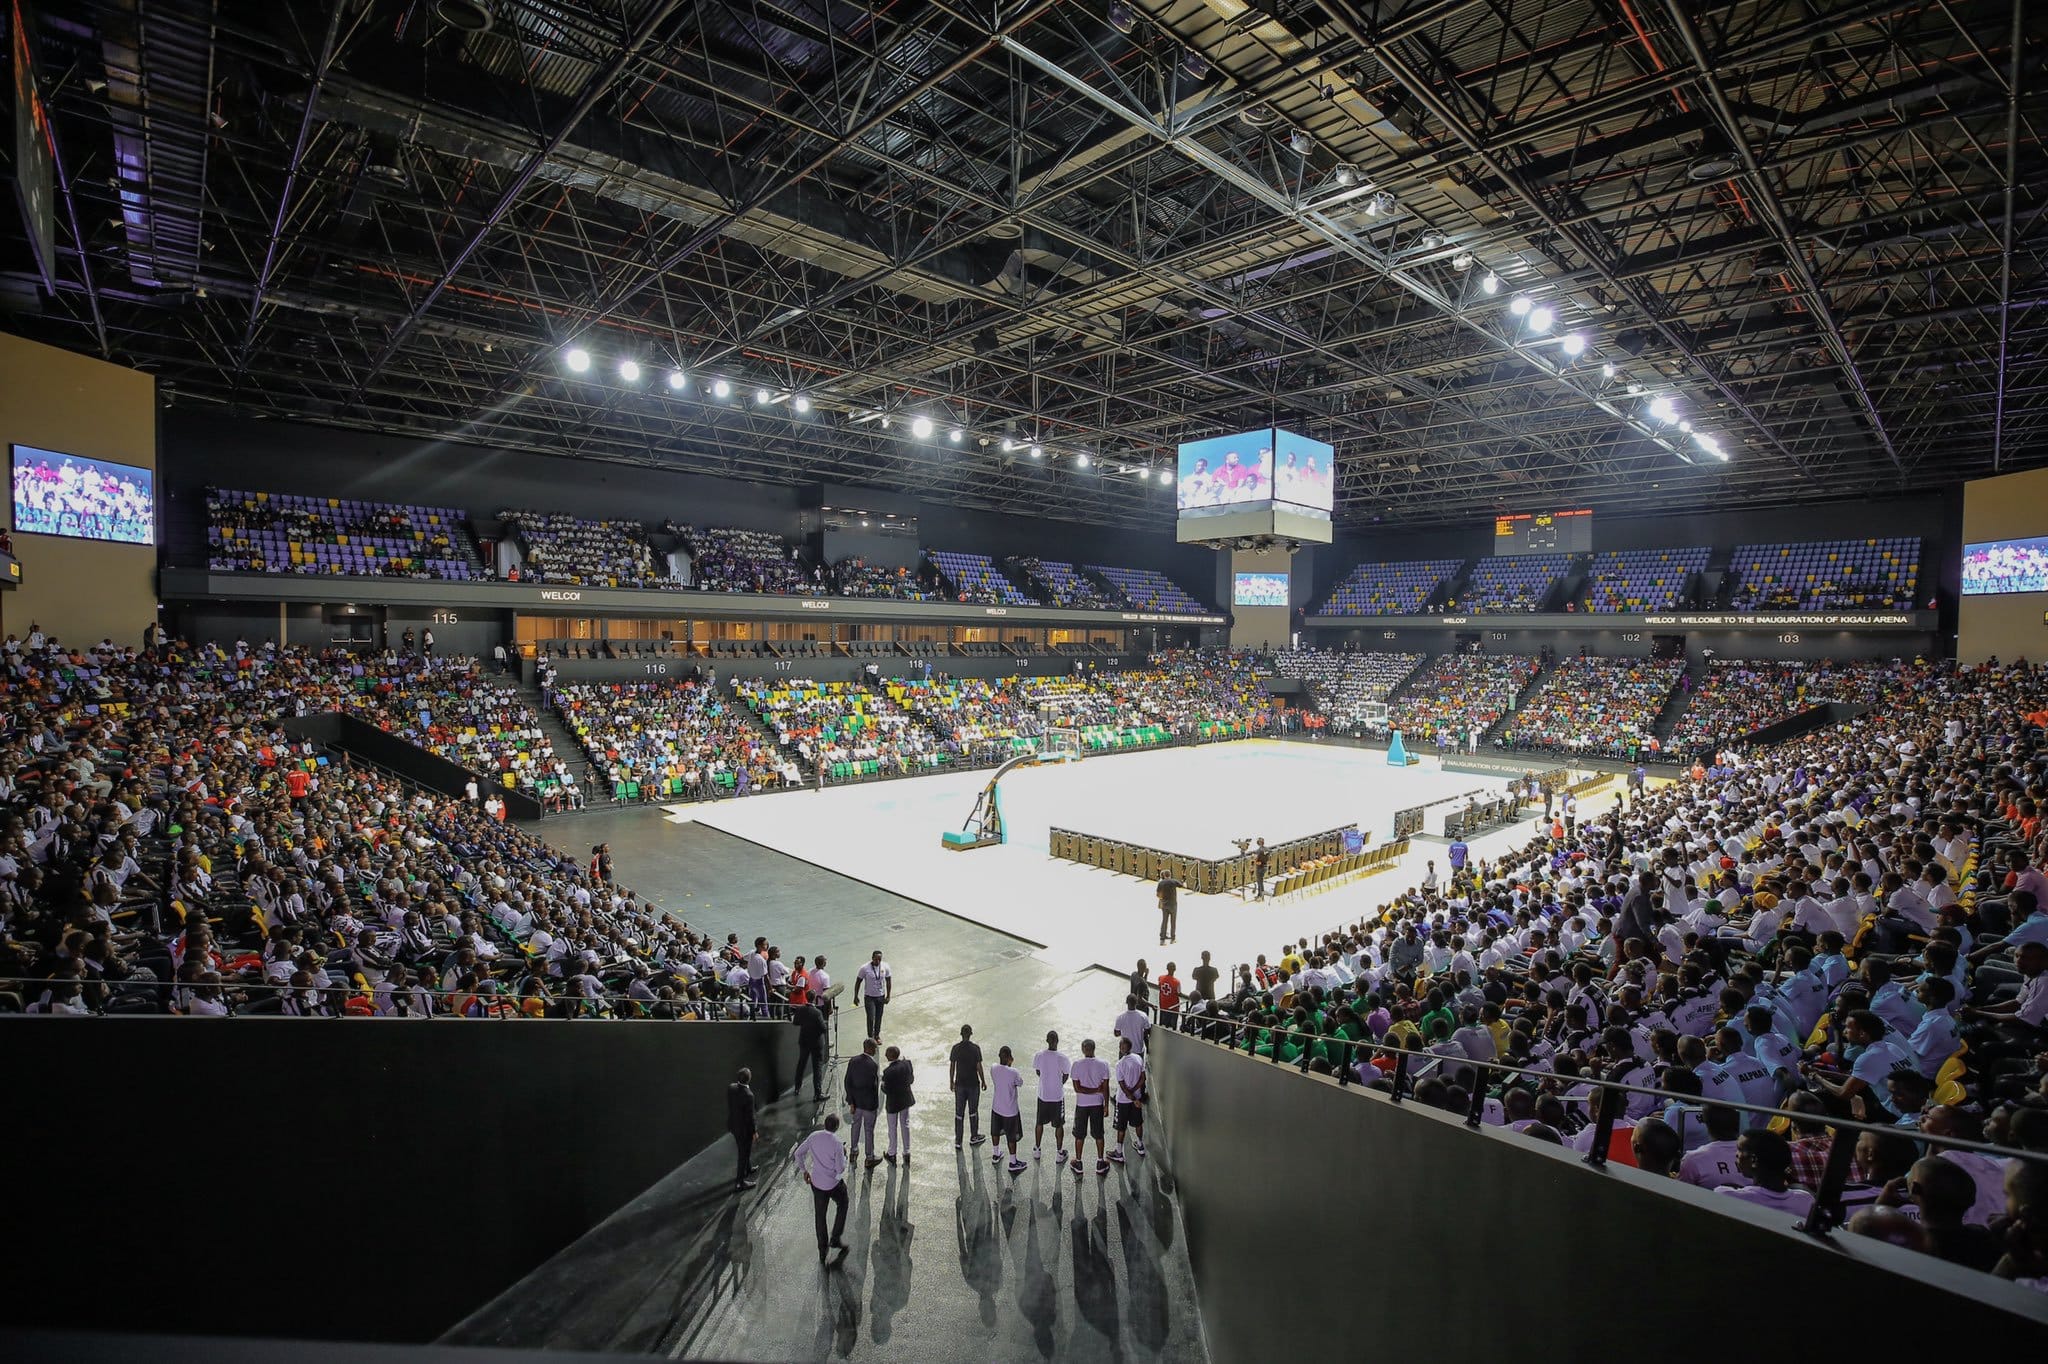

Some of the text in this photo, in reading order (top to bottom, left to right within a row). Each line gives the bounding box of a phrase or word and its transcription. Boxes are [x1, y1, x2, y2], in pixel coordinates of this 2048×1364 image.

[432, 613, 458, 624] 115
[1680, 616, 1721, 624] WELCOME
[1724, 616, 1736, 624] TO
[1737, 616, 1755, 624] THE
[1756, 616, 1823, 624] INAUGURATION
[1622, 633, 1640, 641] 102
[1778, 634, 1799, 643] 103
[774, 661, 792, 670] 117
[909, 660, 923, 668] 118
[1016, 659, 1028, 667] 119
[645, 663, 666, 674] 116
